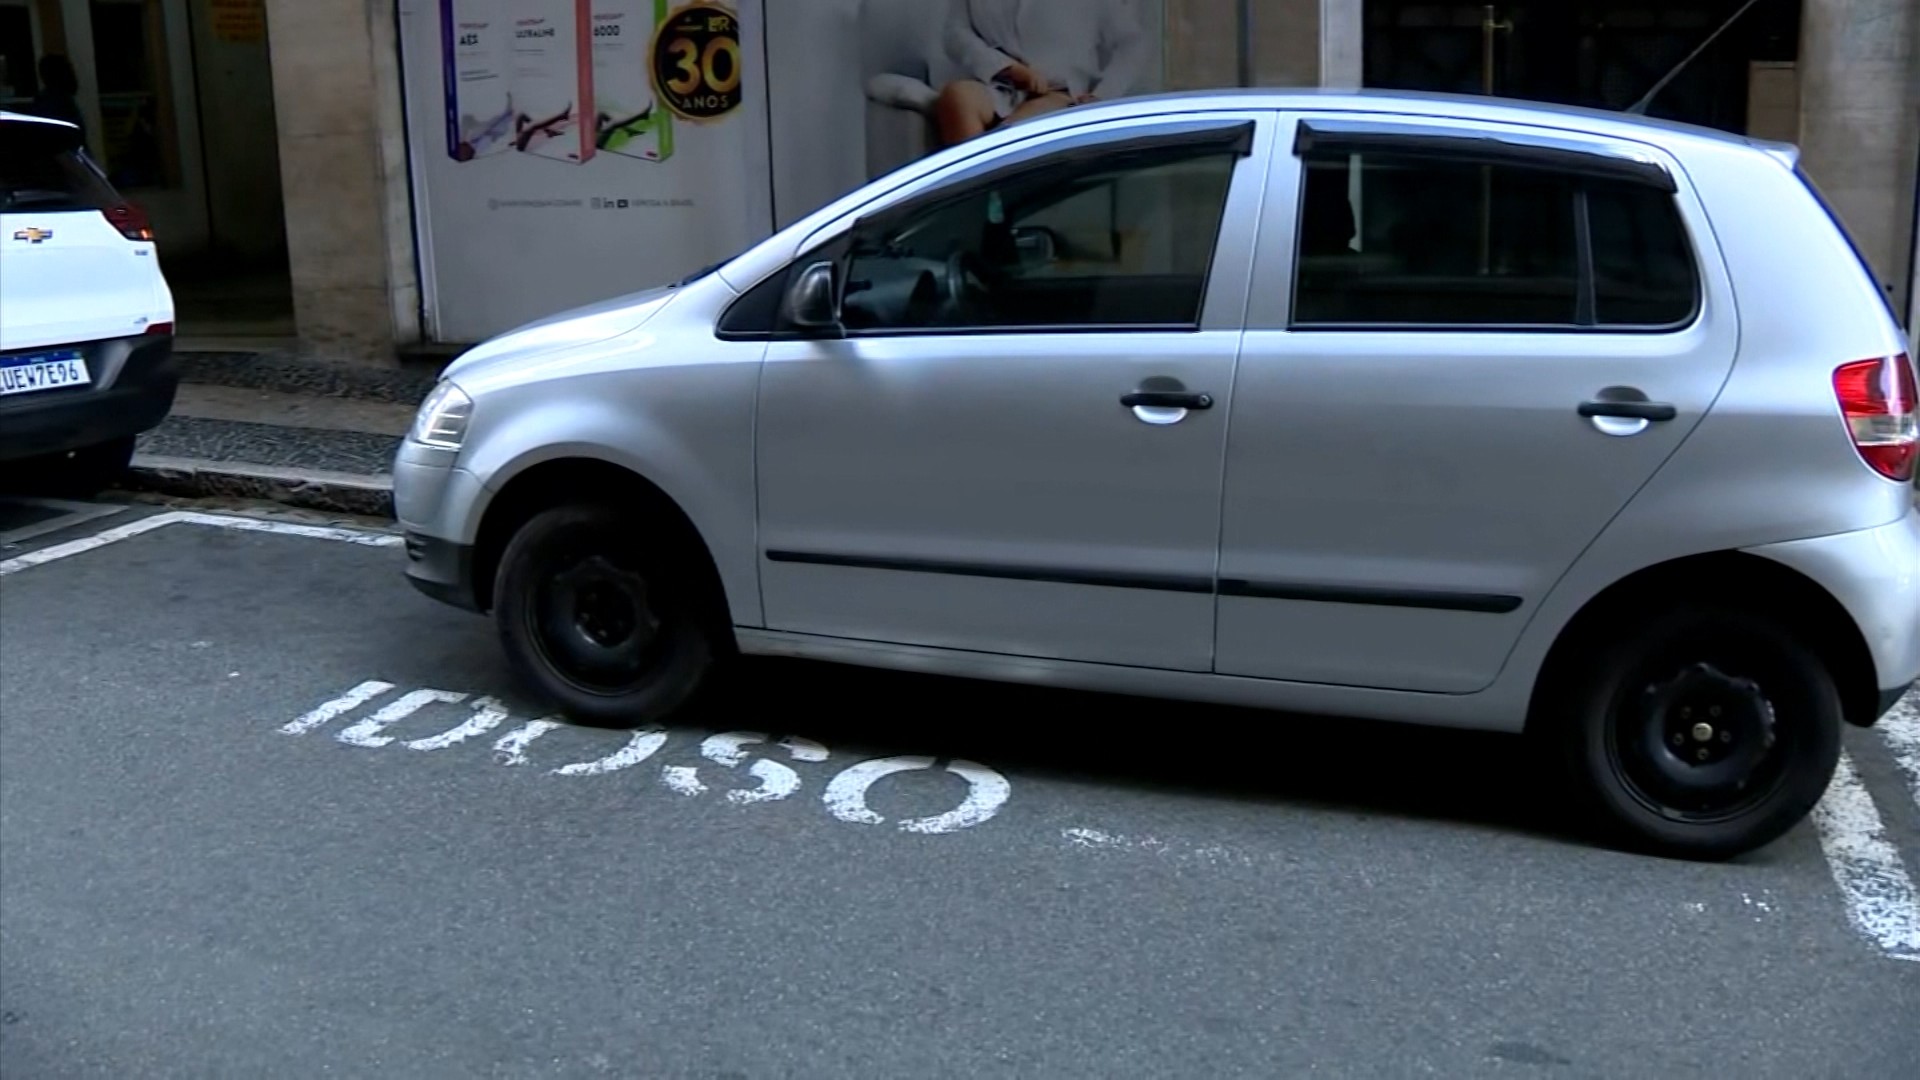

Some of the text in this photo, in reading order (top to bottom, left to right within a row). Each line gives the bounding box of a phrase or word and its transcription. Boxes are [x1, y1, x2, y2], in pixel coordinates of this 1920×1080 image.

[666, 35, 741, 94] 30
[682, 95, 729, 109] ANOS
[277, 680, 1011, 835] IDOSO
